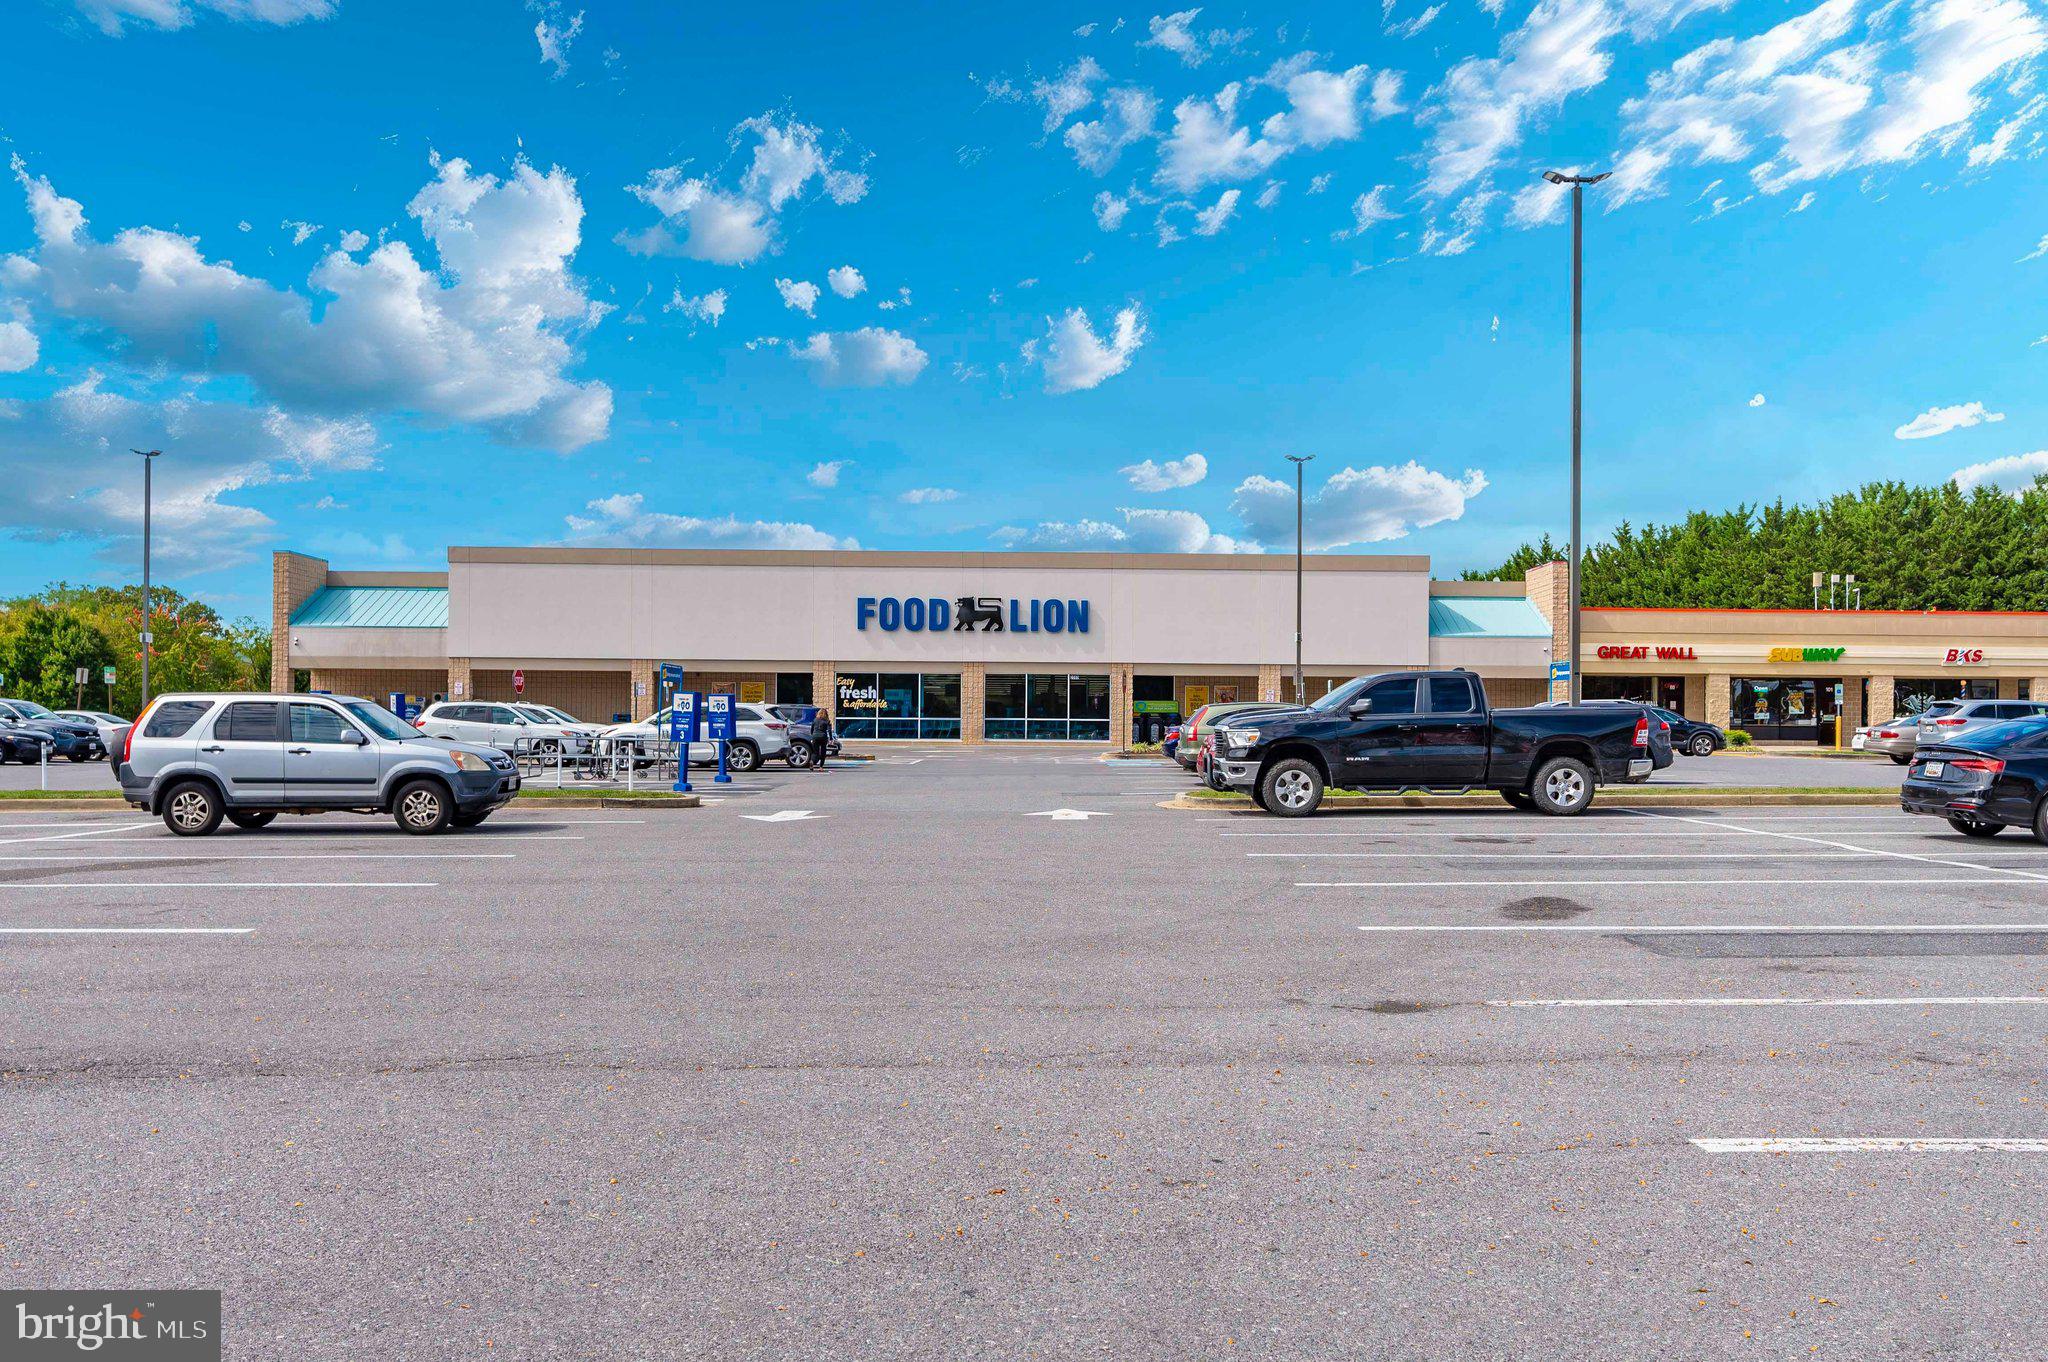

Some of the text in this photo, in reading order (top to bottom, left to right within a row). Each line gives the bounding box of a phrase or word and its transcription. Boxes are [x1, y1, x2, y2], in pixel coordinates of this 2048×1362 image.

[857, 597, 1089, 633] FOOD LION
[1597, 645, 1698, 660] GREAT WALL
[1768, 647, 1846, 663] SUBWAY
[837, 676, 855, 690] Easy
[840, 686, 877, 699] fresh
[680, 731, 685, 739] 3
